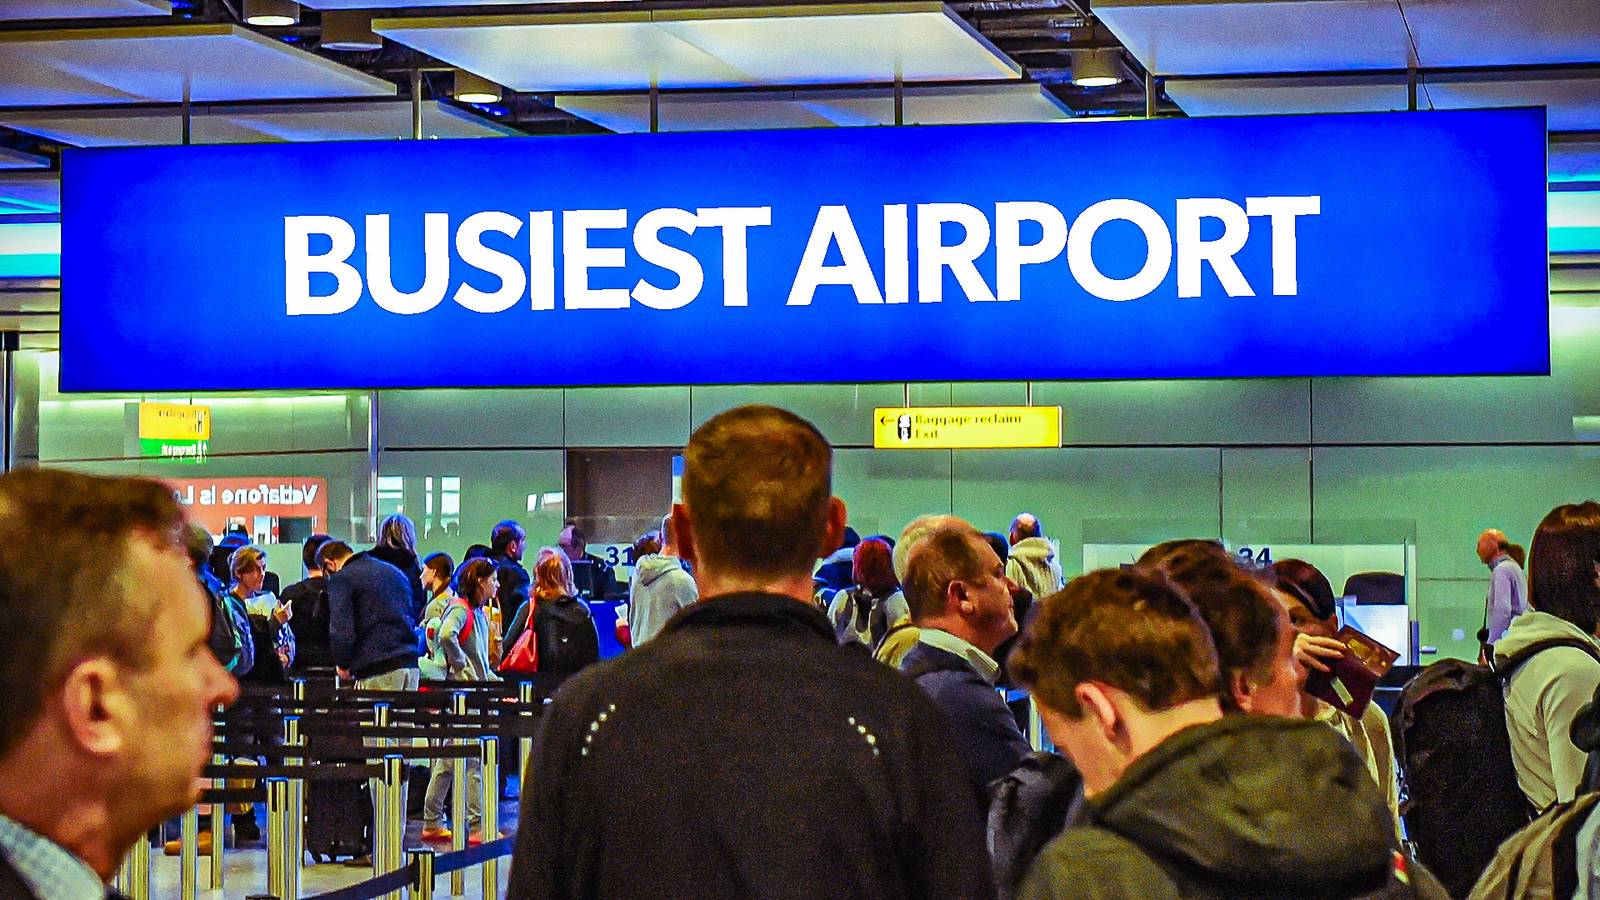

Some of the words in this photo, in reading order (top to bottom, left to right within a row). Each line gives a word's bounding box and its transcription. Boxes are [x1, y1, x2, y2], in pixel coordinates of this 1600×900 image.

[285, 207, 771, 316] BUSIEST
[787, 195, 1321, 306] AIRPORT
[915, 414, 970, 426] Baggage
[975, 413, 1021, 424] reclaim
[915, 429, 938, 439] Exit
[605, 546, 636, 567] 31
